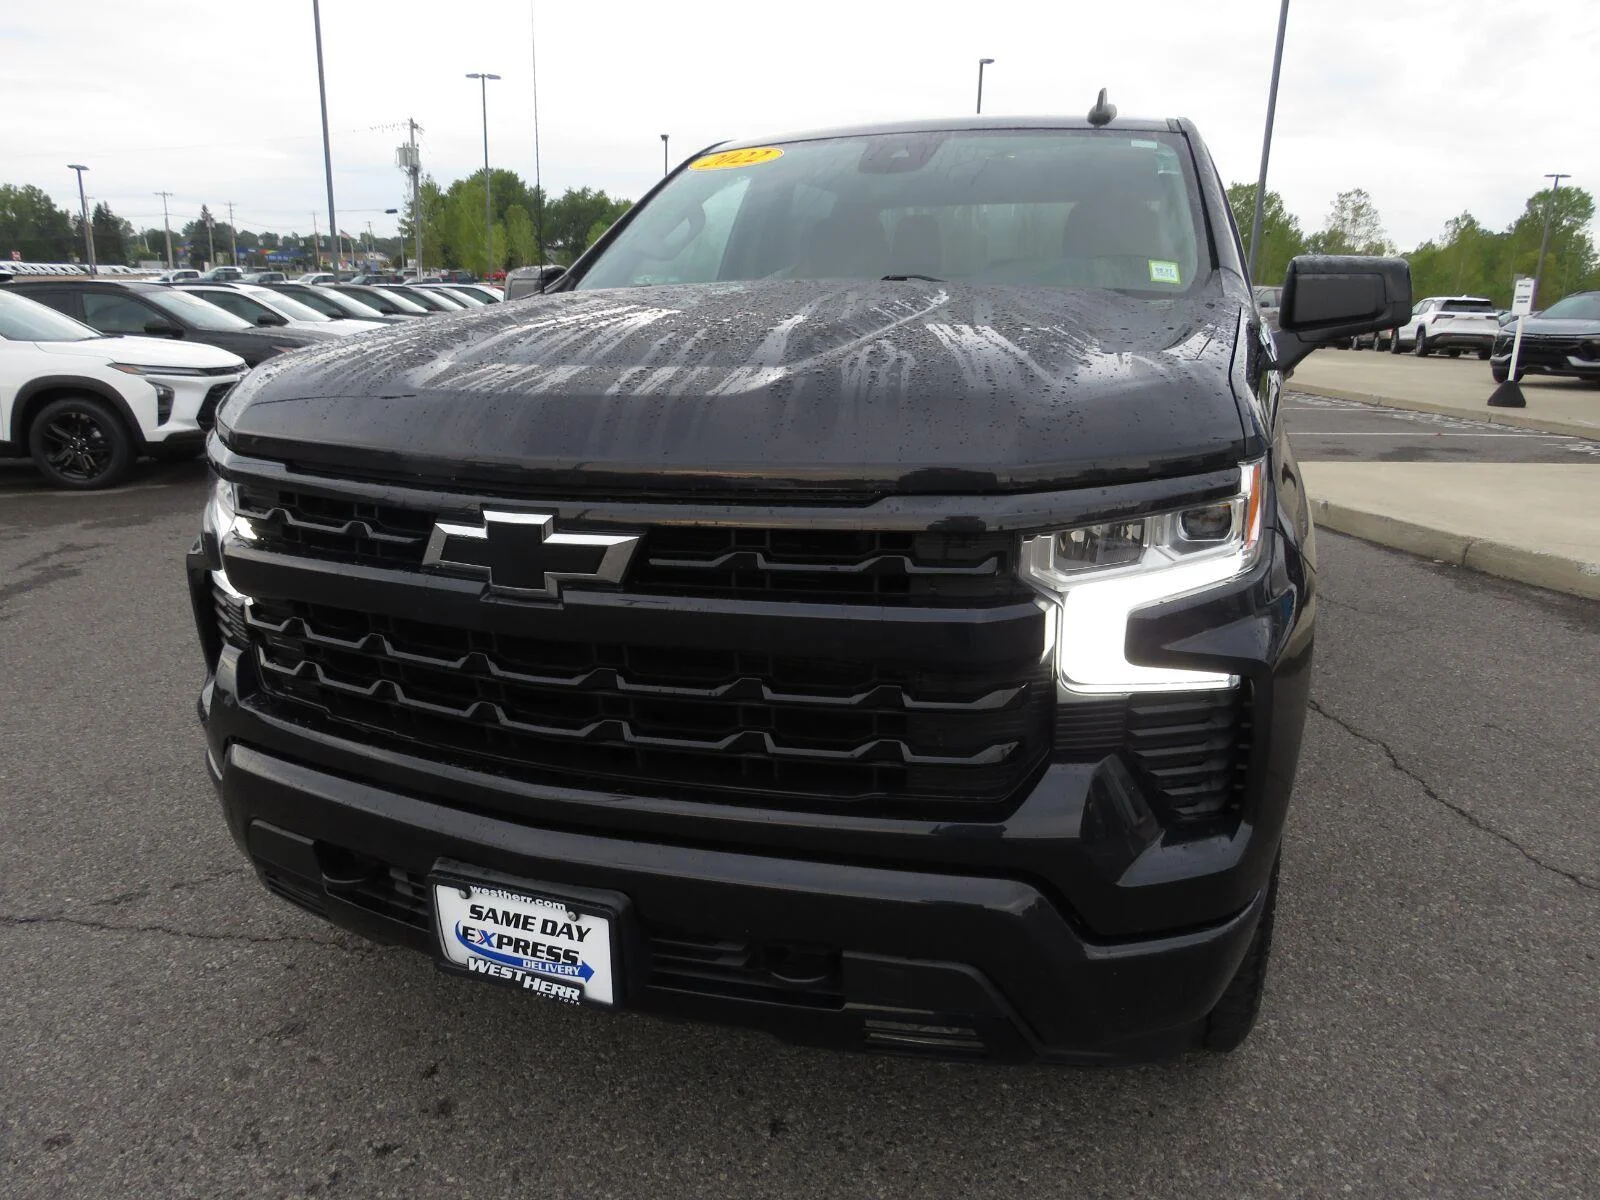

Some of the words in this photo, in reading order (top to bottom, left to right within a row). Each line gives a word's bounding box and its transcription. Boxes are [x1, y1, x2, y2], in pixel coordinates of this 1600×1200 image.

[698, 150, 772, 168] 2022
[470, 885, 566, 912] westherr.com
[469, 904, 536, 932] SAME
[540, 918, 592, 943] DAY
[462, 926, 580, 967] EXPRESS
[522, 959, 581, 977] DELIVERY
